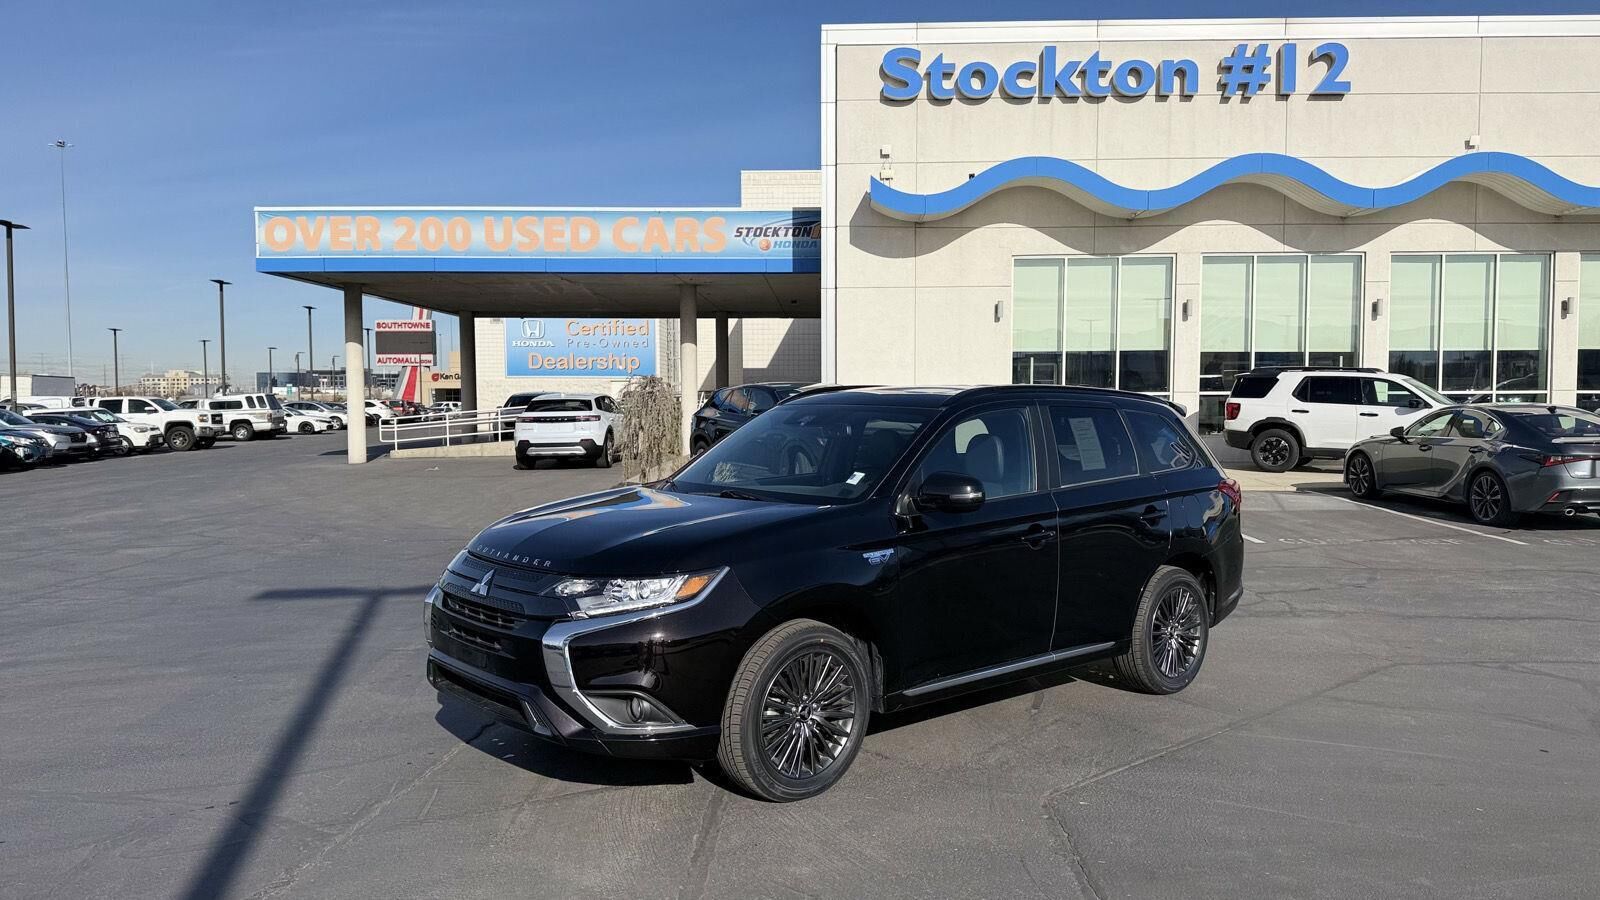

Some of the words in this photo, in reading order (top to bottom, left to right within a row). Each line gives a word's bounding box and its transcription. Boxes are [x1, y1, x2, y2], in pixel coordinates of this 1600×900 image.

[882, 46, 1199, 100] Stockton
[1220, 42, 1352, 98] #12
[264, 216, 381, 251] OVER
[393, 216, 472, 251] 200
[483, 216, 600, 252] USED
[612, 216, 728, 252] CARS
[773, 240, 817, 249] HONDA
[566, 319, 650, 337] Certified
[511, 340, 555, 348] HONDA
[567, 338, 649, 348] Pre-Owned
[527, 352, 641, 374] Dealership
[477, 544, 552, 568] OUTLANDER
